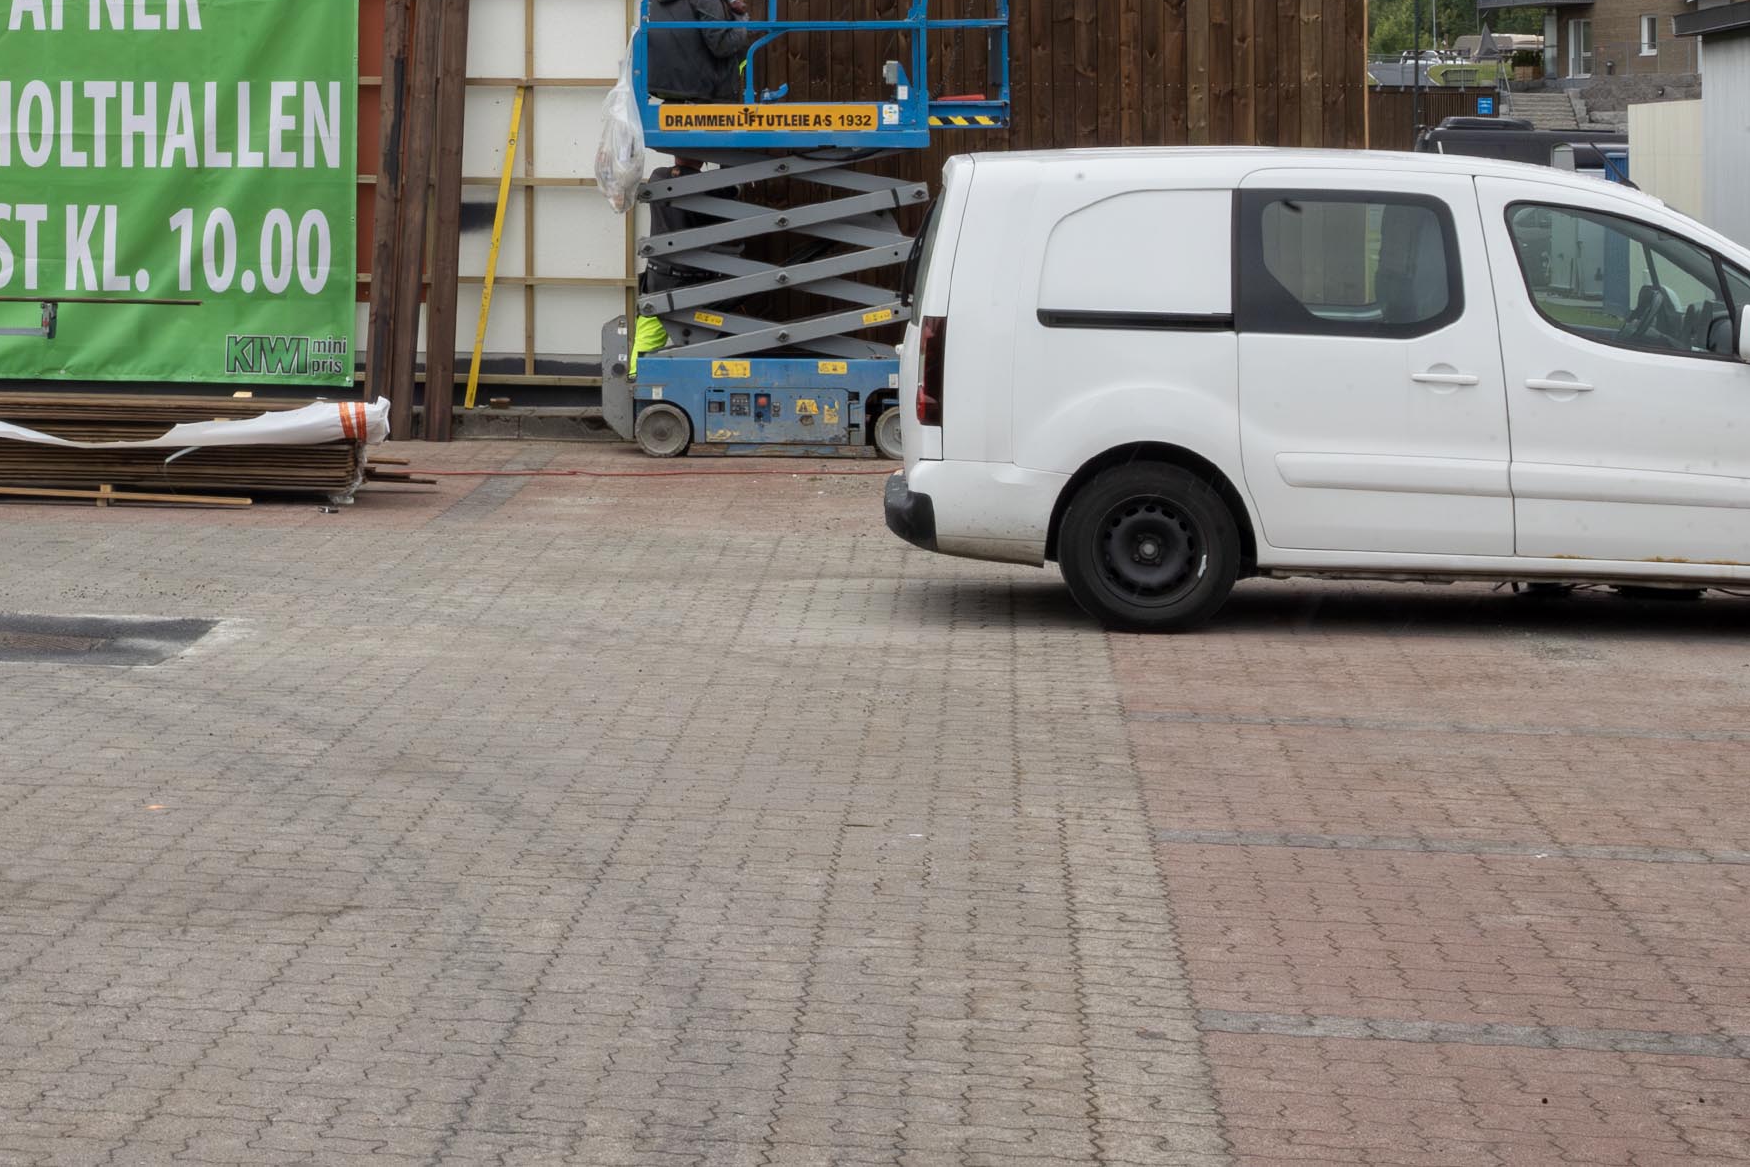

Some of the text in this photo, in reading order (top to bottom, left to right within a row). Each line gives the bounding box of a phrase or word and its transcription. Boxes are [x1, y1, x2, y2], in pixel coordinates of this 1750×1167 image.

[665, 114, 735, 127] DRAMMEN
[838, 114, 871, 127] 1932
[64, 204, 150, 293] KL.
[168, 206, 332, 295] 10.00
[225, 334, 347, 375] KIWI mini
[312, 356, 343, 375] pris
